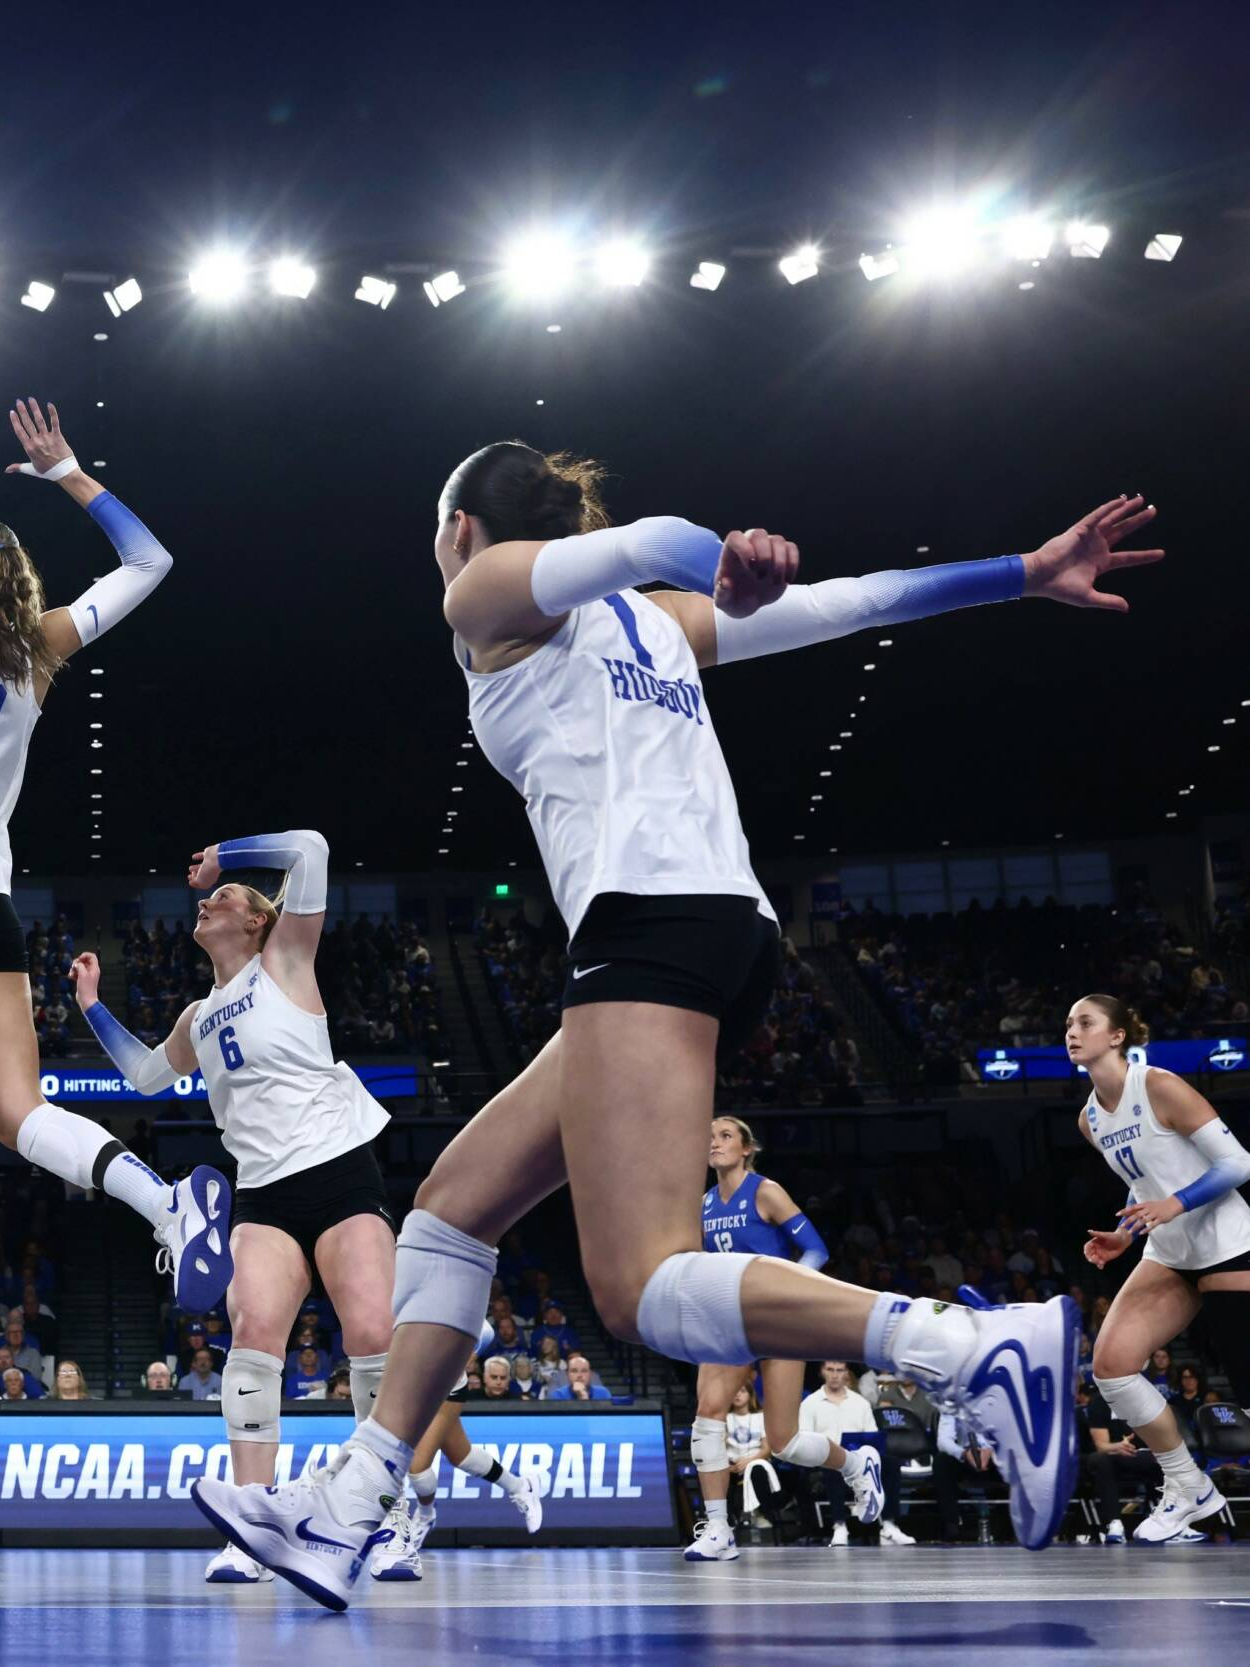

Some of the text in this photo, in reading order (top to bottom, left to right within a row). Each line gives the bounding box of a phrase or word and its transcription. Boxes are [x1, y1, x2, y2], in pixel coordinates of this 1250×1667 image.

[199, 991, 254, 1041] KENTUCKY
[218, 1025, 245, 1071] 6
[40, 1075, 59, 1096] 0
[63, 1079, 121, 1092] HITTING
[174, 1075, 193, 1095] 0
[1100, 1123, 1142, 1150] KENTUCKY
[1115, 1145, 1144, 1180] 17
[714, 1231, 733, 1253] 12
[1211, 1406, 1236, 1424] UK
